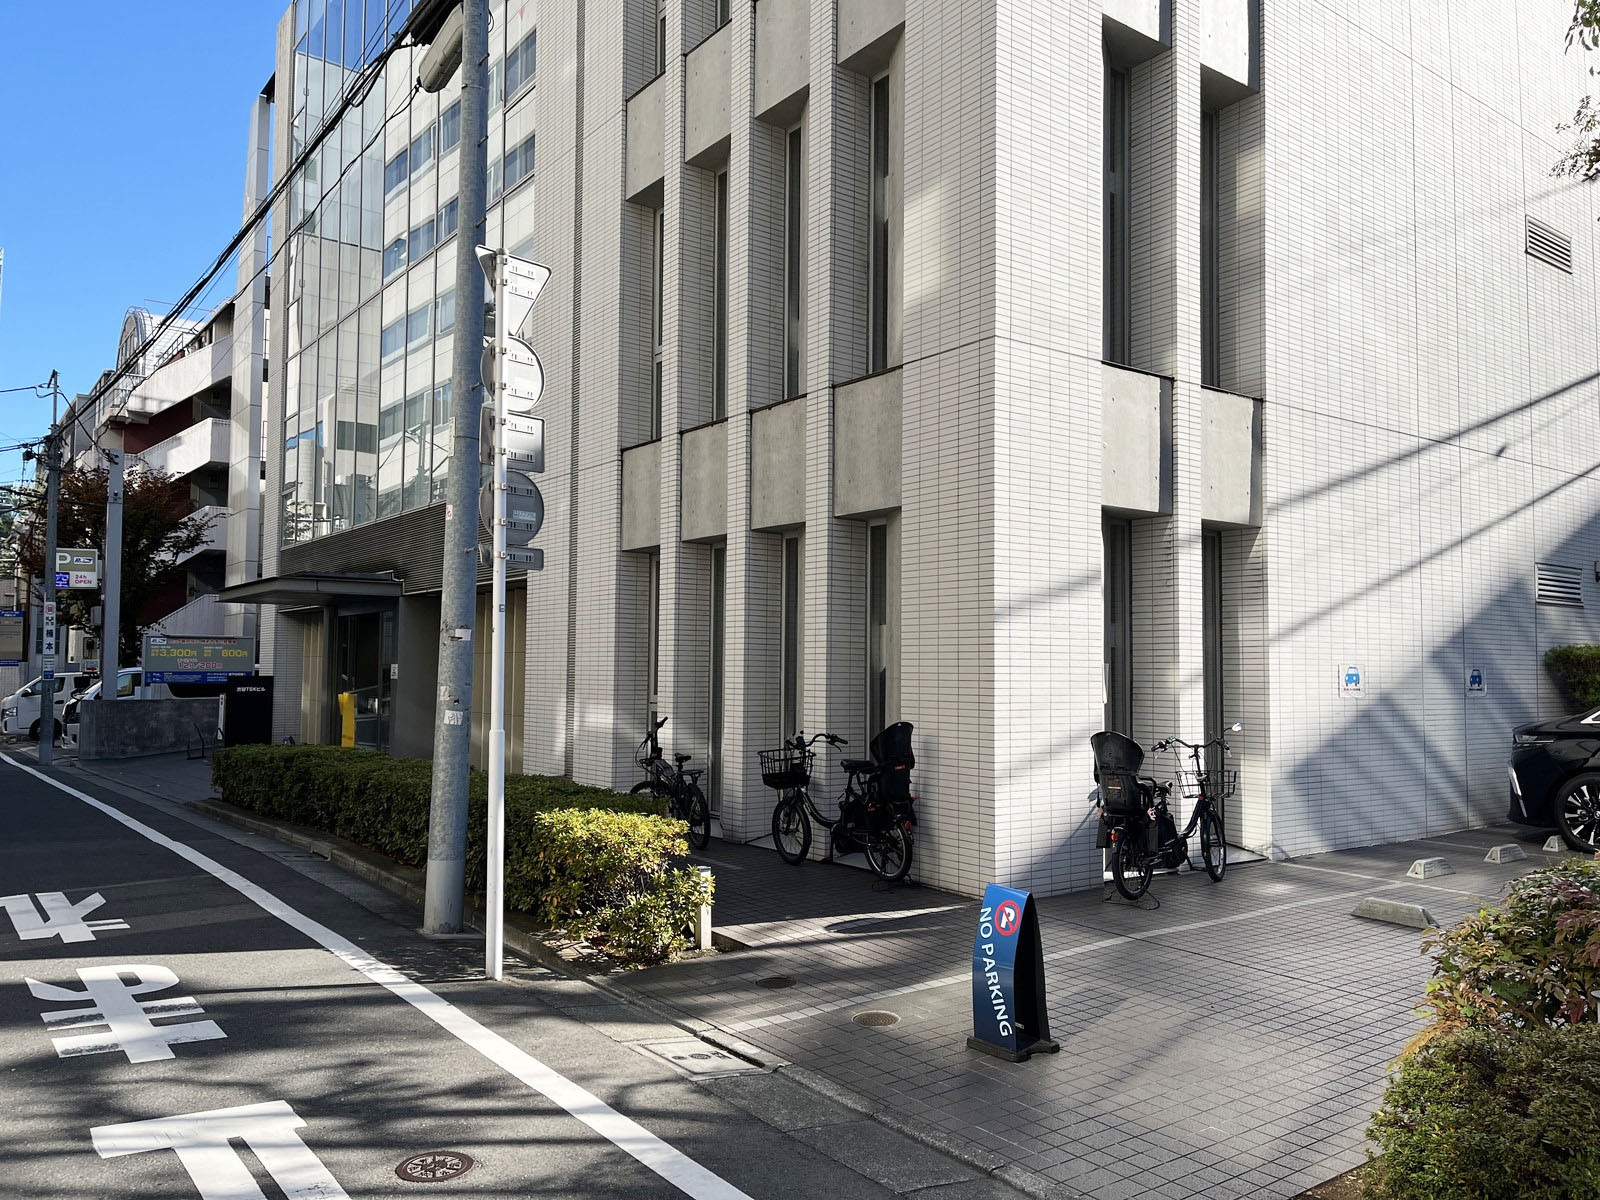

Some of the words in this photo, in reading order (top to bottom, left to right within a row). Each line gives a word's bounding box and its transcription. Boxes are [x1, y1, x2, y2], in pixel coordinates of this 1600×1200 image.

[56, 552, 71, 572] P
[979, 906, 993, 938] NO
[981, 943, 1013, 1038] PARKING
